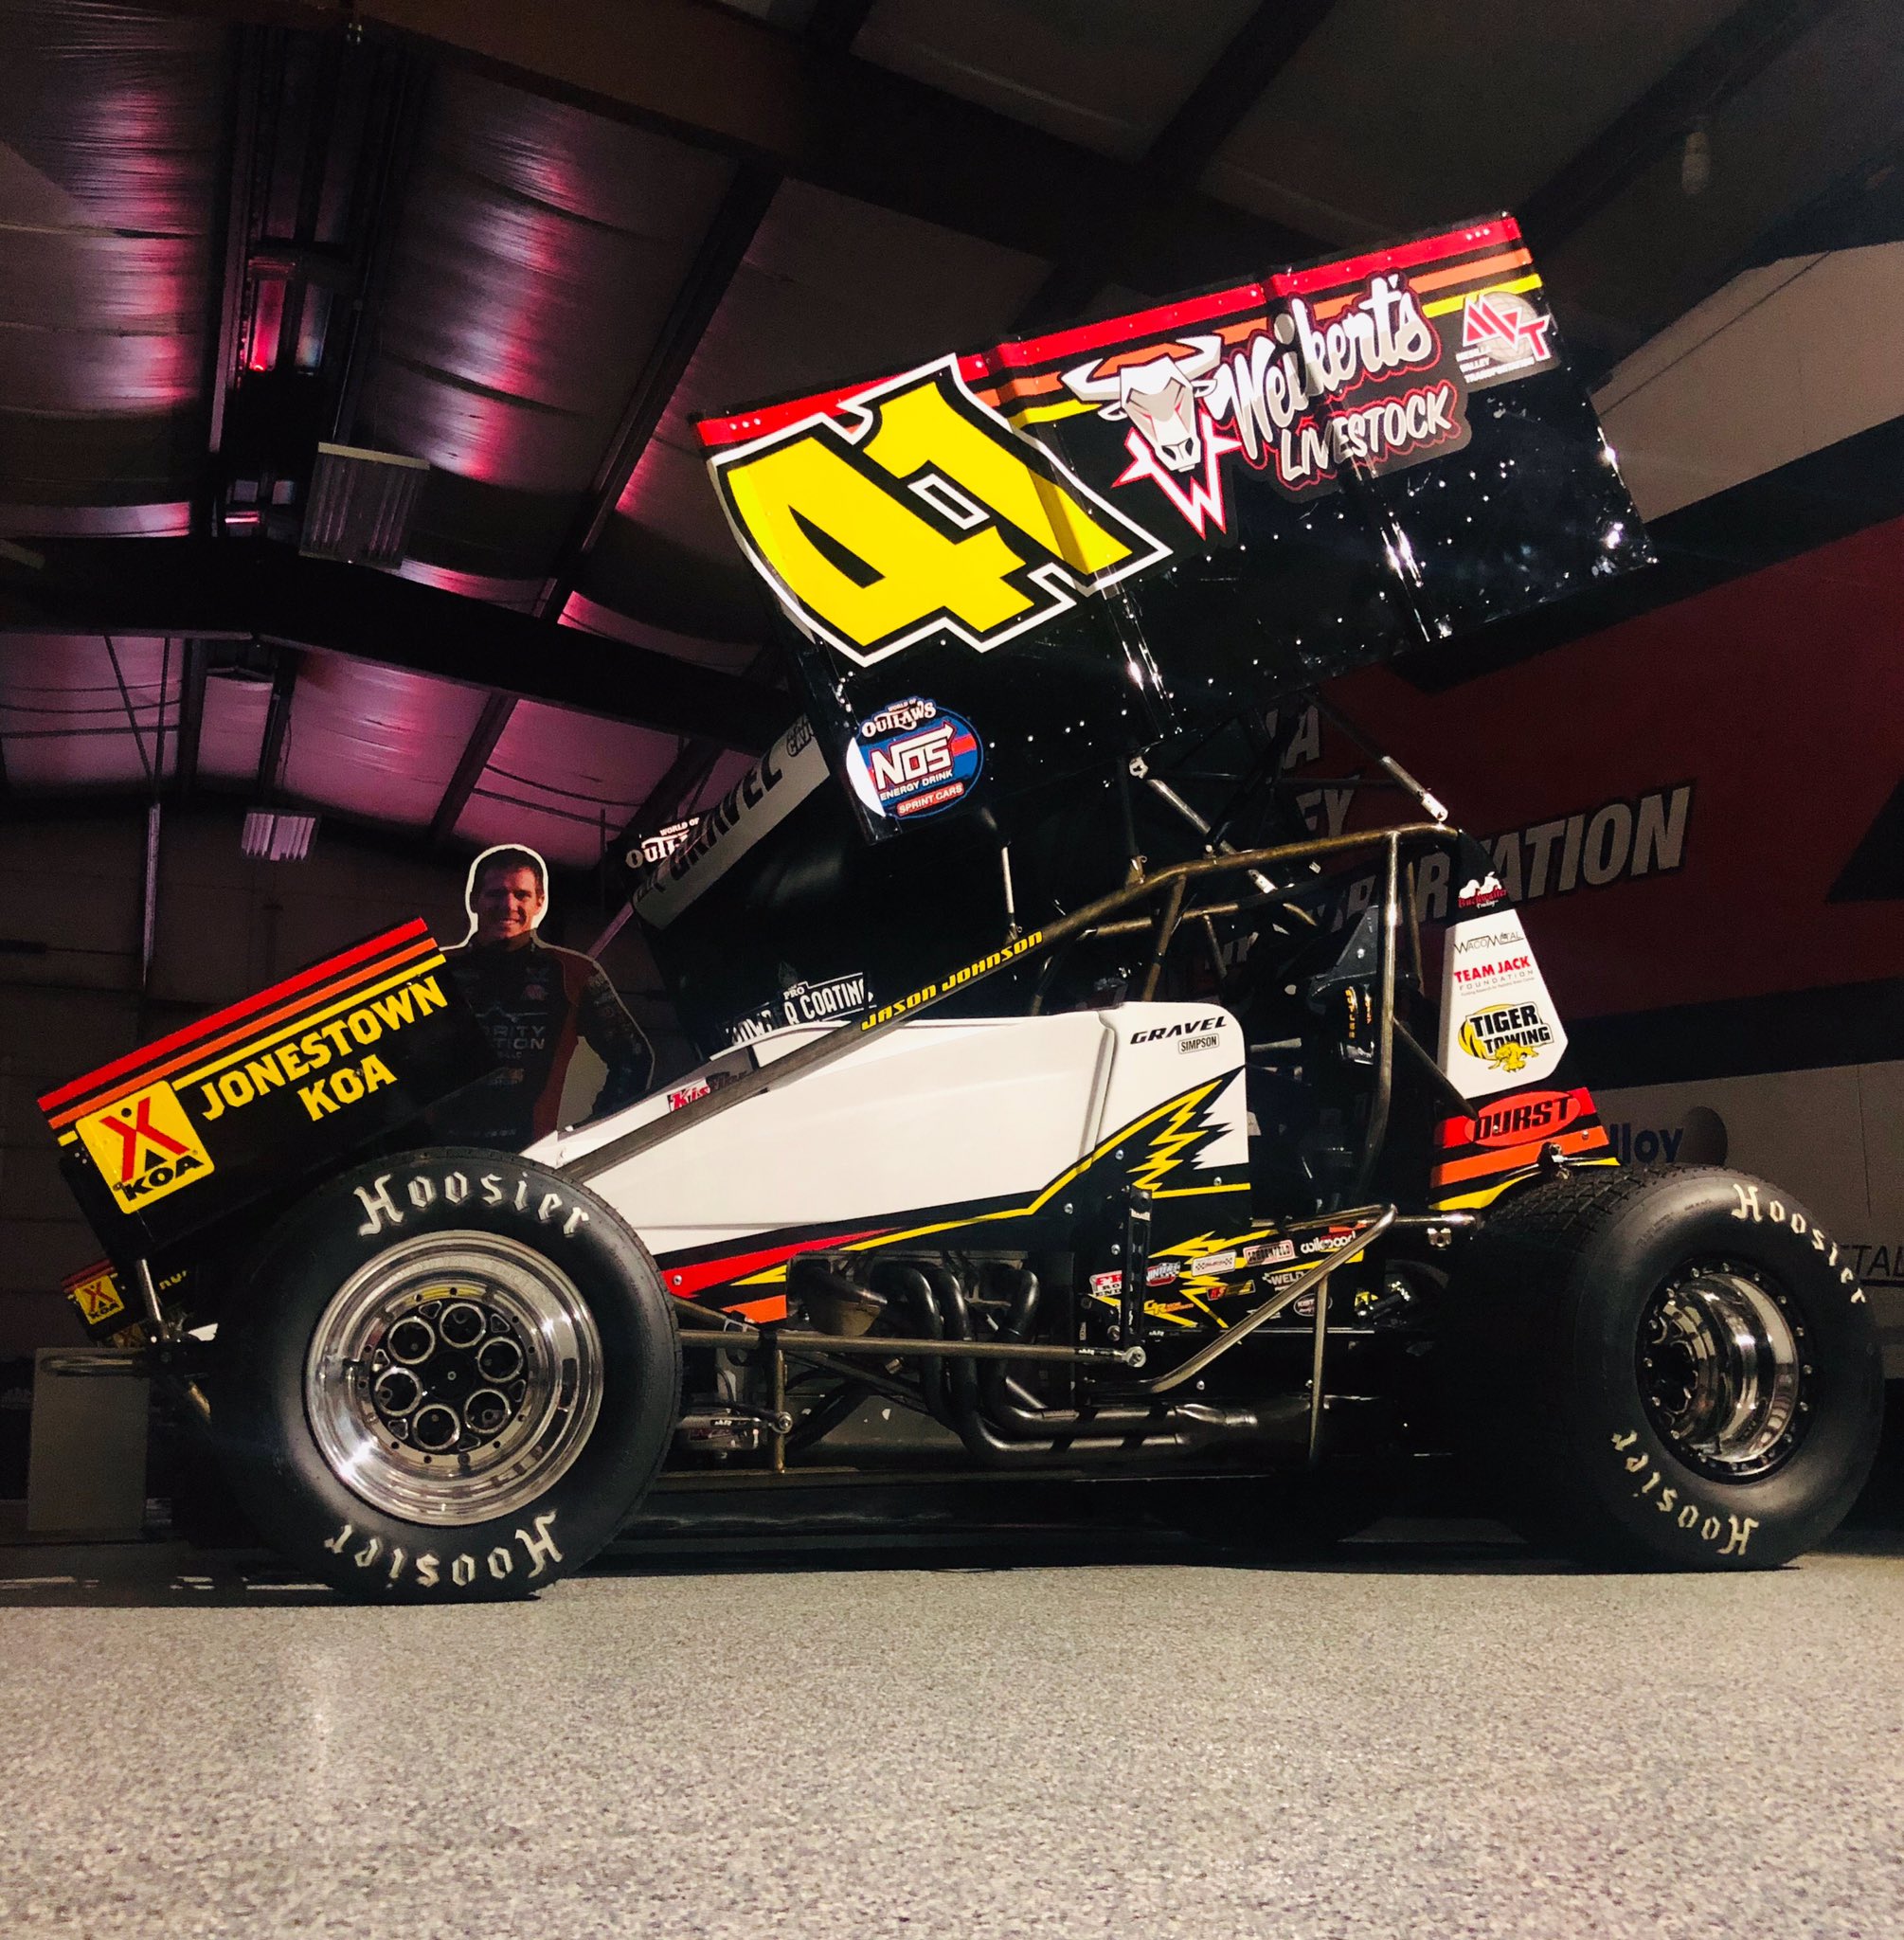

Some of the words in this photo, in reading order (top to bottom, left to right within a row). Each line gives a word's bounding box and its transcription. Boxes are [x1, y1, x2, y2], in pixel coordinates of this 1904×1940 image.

[1211, 273, 1434, 460] Weikert's
[1281, 390, 1452, 482] LIVESTOCK
[717, 367, 1156, 656] 41
[862, 701, 937, 737] OUTLAWS
[871, 722, 955, 792] NOS
[880, 781, 920, 801] ENERGY
[922, 769, 954, 787] DRINK
[899, 797, 935, 814] SPRINT
[935, 784, 963, 800] CARS
[660, 822, 689, 837] WORLD
[783, 986, 805, 1000] PRO
[860, 983, 937, 1032] JASON
[942, 931, 1044, 993] JOHNSON
[1454, 963, 1496, 983] TEAM
[1498, 956, 1531, 975] JACK
[1460, 969, 1535, 992] FOUNDATION
[1130, 1015, 1228, 1045] GRAVEL
[1180, 1035, 1218, 1053] SIMPSON
[1469, 1006, 1539, 1038] TIGER
[1484, 1026, 1551, 1054] TOWING
[201, 975, 448, 1122] JONESTOWN
[296, 1053, 398, 1122] KOA
[117, 1153, 206, 1201] KOA
[355, 1172, 590, 1237] Hoosier
[1731, 1183, 1867, 1304] Hoosier
[1610, 1428, 1760, 1557] Hoosier
[324, 1509, 564, 1589] Hoosier
